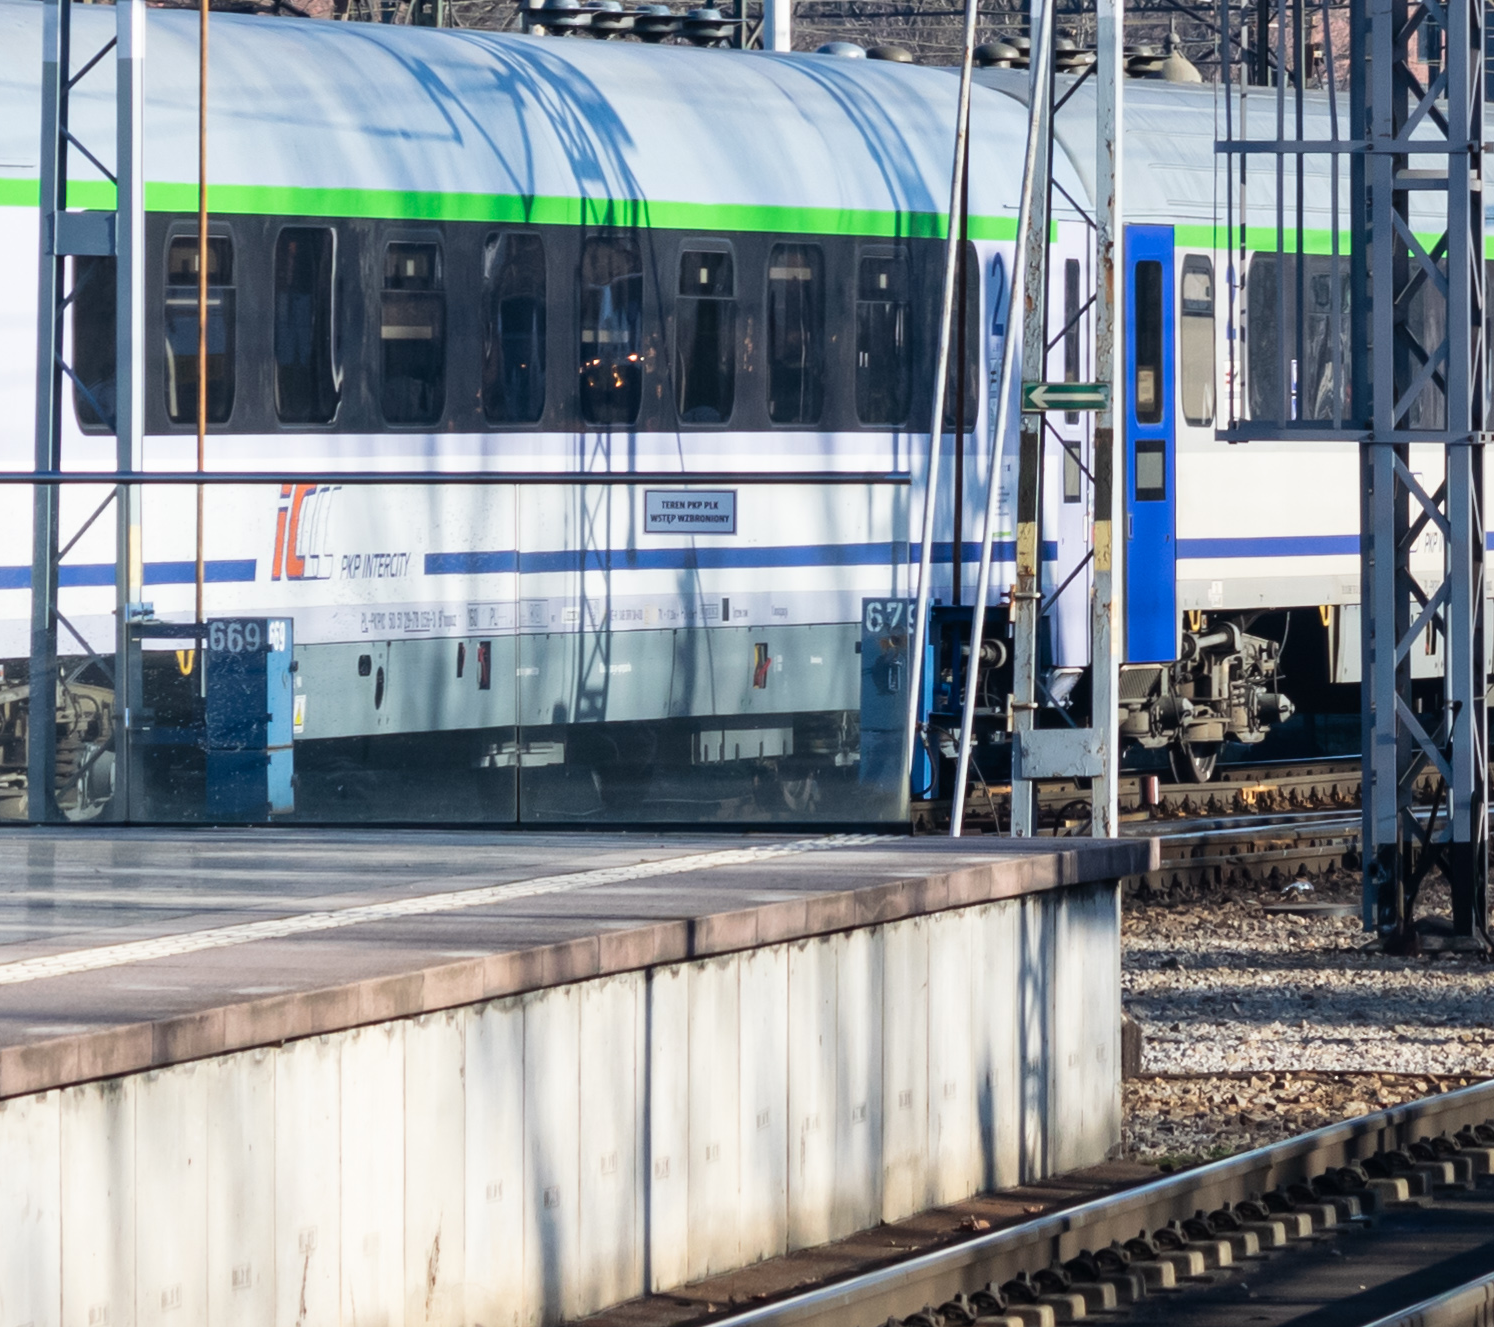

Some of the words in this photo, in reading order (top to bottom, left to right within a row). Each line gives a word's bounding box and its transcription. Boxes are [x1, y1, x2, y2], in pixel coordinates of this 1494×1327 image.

[991, 251, 1004, 337] 2
[649, 513, 677, 524] WSTĘP
[677, 513, 730, 523] WZBRONIONY
[661, 500, 686, 509] TEREN
[687, 500, 702, 509] PKP
[703, 500, 719, 510] PLK
[340, 554, 361, 580] PKP
[362, 552, 412, 579] INTERCITY
[209, 621, 261, 652] 669
